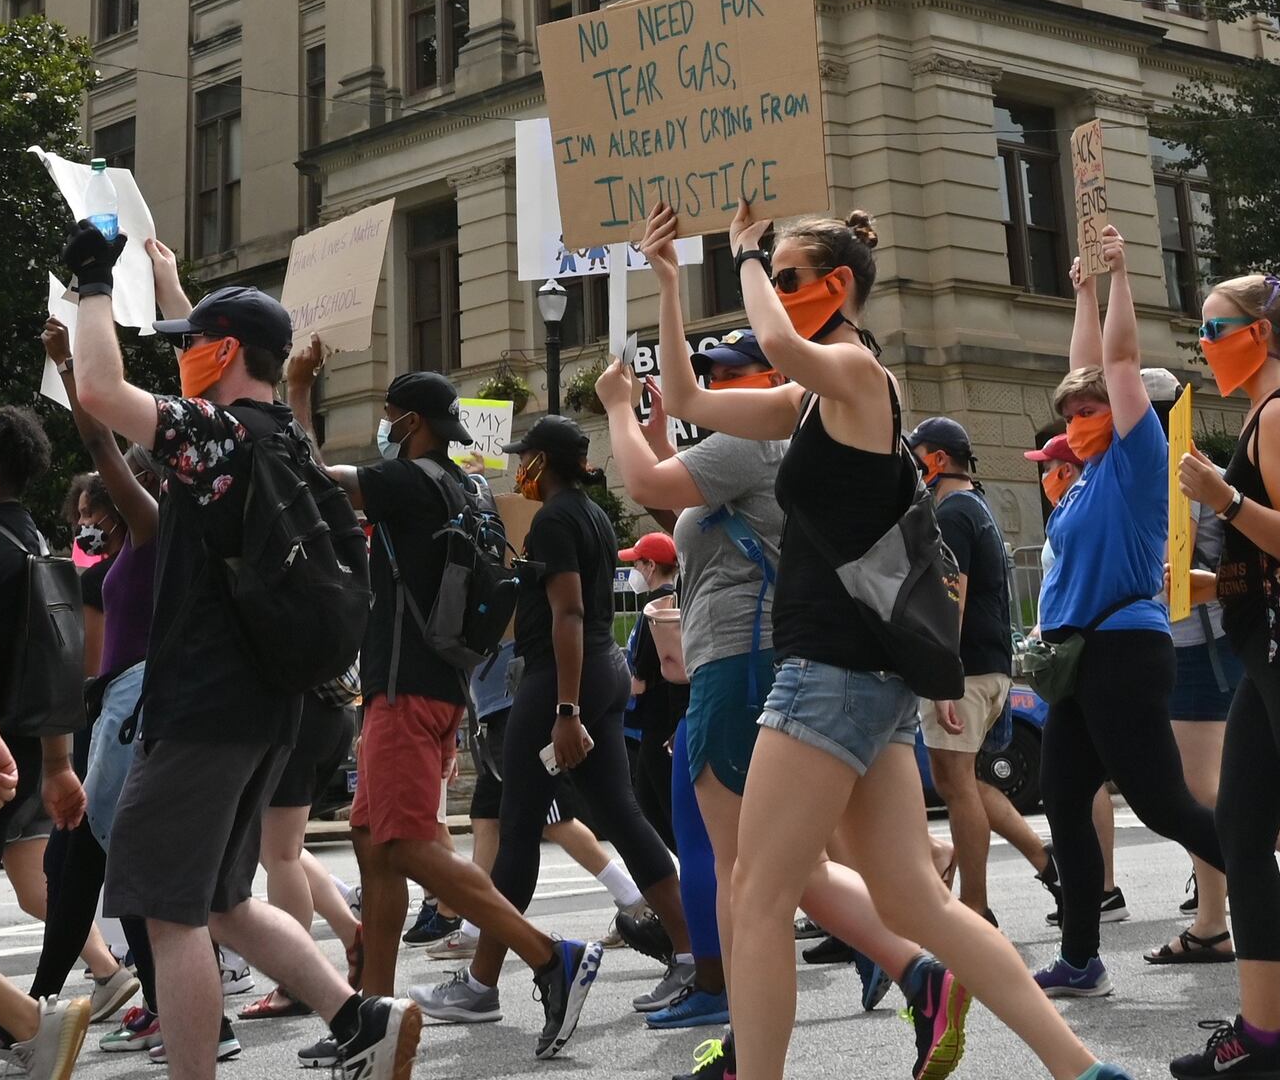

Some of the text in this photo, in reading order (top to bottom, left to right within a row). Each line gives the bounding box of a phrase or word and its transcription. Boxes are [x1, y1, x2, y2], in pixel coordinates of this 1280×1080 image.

[578, 20, 609, 62] NO
[637, 0, 695, 51] NEED
[593, 40, 737, 120] TEAR GAS,
[556, 92, 810, 164] I'M ALREADY CRYING FROM
[594, 158, 778, 227] INJUSTICE
[476, 412, 507, 433] MY
